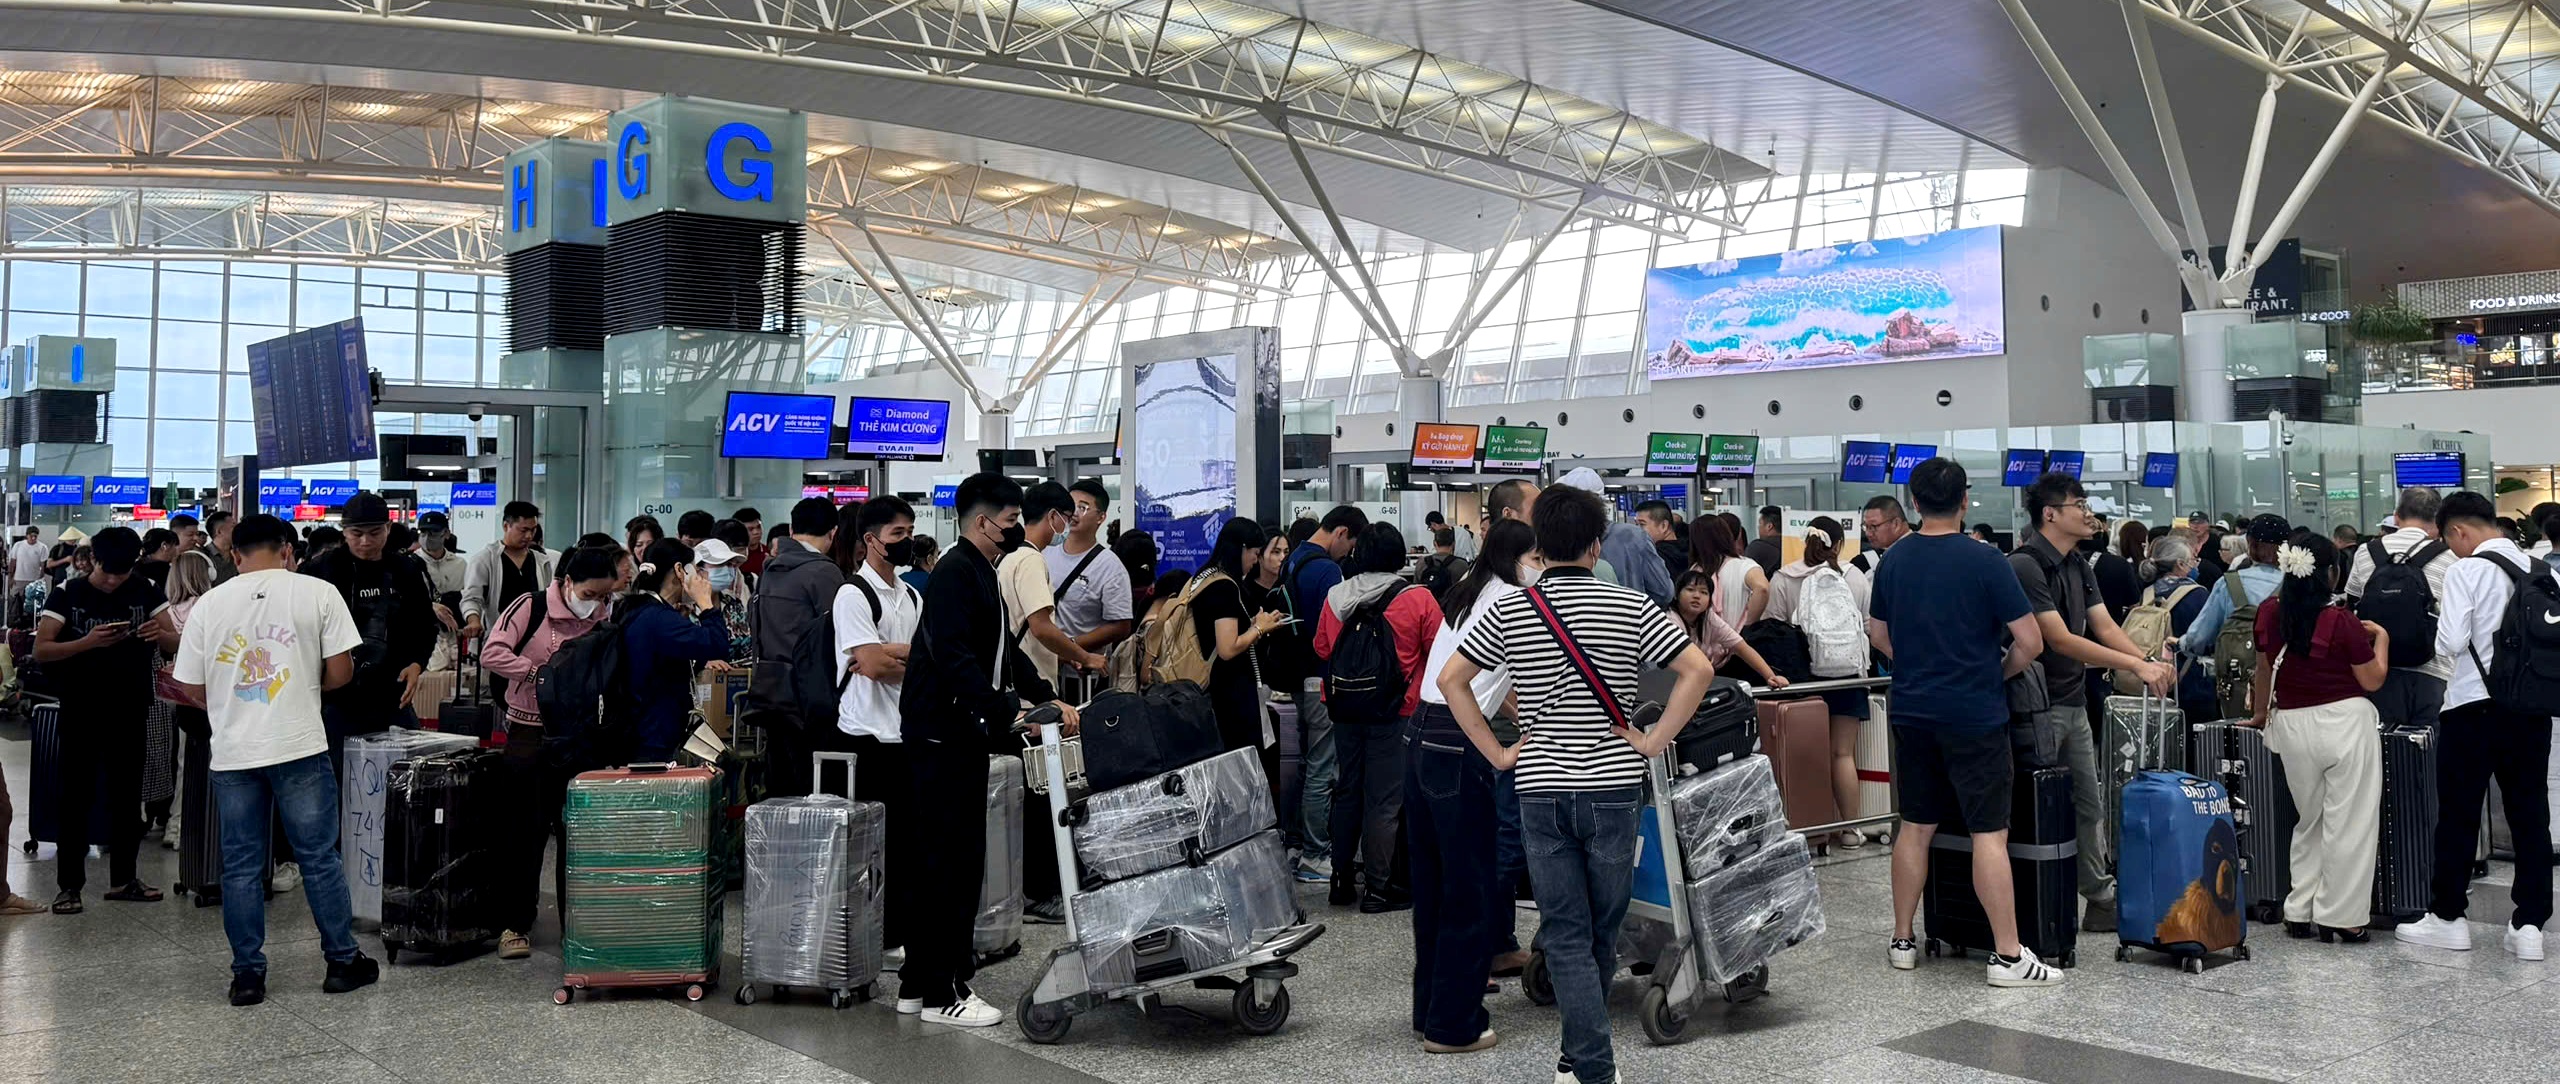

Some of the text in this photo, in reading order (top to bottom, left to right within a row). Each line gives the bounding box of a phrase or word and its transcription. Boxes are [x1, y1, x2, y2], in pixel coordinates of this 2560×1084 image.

[617, 121, 649, 200] G
[706, 122, 774, 203] G
[512, 159, 537, 233] H
[2470, 297, 2506, 310] FOOD
[2507, 297, 2517, 307] &
[886, 408, 930, 420] Diamond
[728, 413, 781, 432] ACV
[859, 419, 937, 434] THẺ KIM CƯƠNG
[2432, 438, 2463, 452] RECHECK
[1846, 454, 1868, 466] ACV
[27, 484, 56, 494] ACV
[93, 484, 121, 494] ACV
[311, 486, 334, 496] ACV
[453, 490, 476, 498] ACV
[934, 490, 952, 499] ACV
[644, 503, 673, 515] G-00
[216, 623, 297, 665] MLB LIKE
[2179, 785, 2217, 799] BAD TO
[2192, 800, 2208, 814] THE
